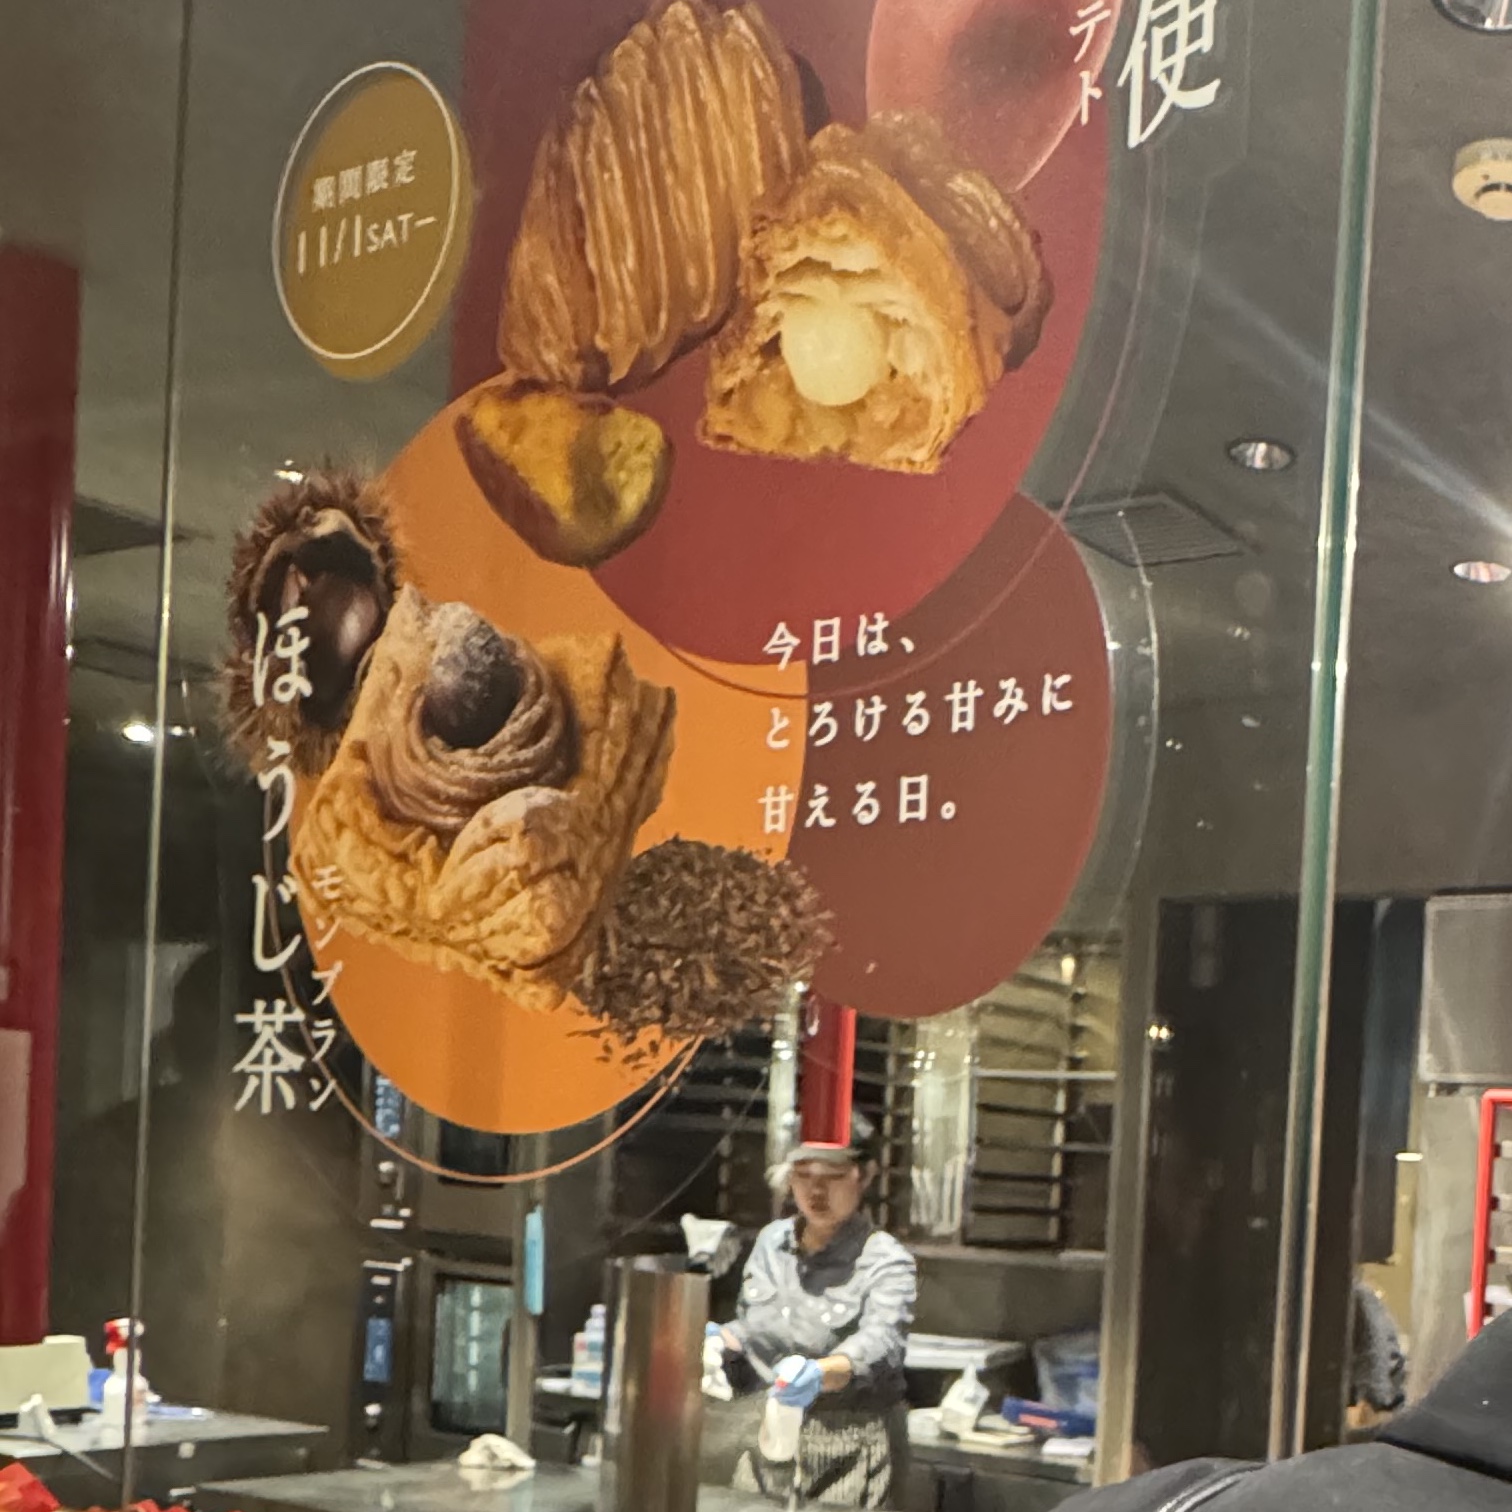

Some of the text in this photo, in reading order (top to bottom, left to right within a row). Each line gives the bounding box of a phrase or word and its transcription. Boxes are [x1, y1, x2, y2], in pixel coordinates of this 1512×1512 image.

[1116, 0, 1221, 149] 便
[763, 612, 915, 671] 今日は、
[765, 673, 1073, 751] とろける甘みに
[758, 774, 957, 834] 甘える日。
[233, 607, 313, 1115] ほうじ茶
[310, 865, 343, 1112] モンブラン
